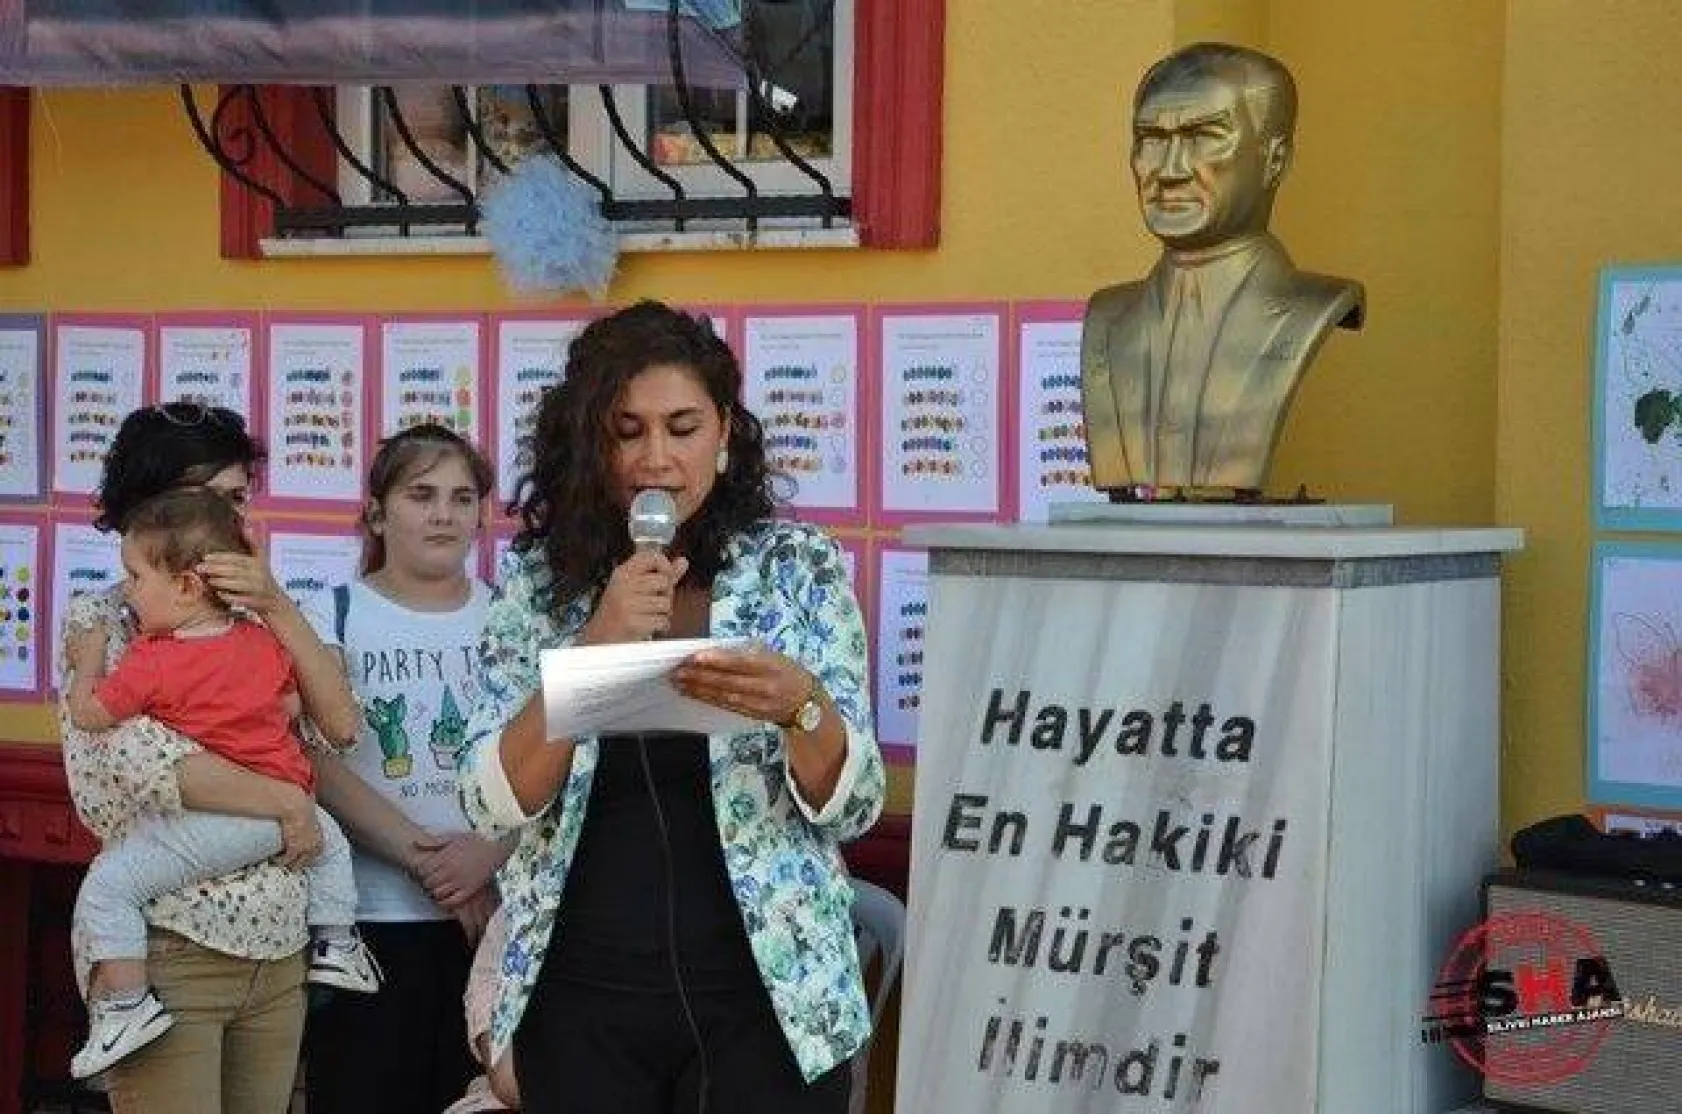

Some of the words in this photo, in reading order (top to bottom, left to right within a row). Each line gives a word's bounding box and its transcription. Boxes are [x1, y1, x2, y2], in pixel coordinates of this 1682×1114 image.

[363, 649, 443, 684] PARTY
[980, 688, 1256, 766] Hayatta
[941, 793, 1029, 857] En
[1052, 804, 1287, 879] Hakiki
[987, 905, 1220, 997] Mürşit
